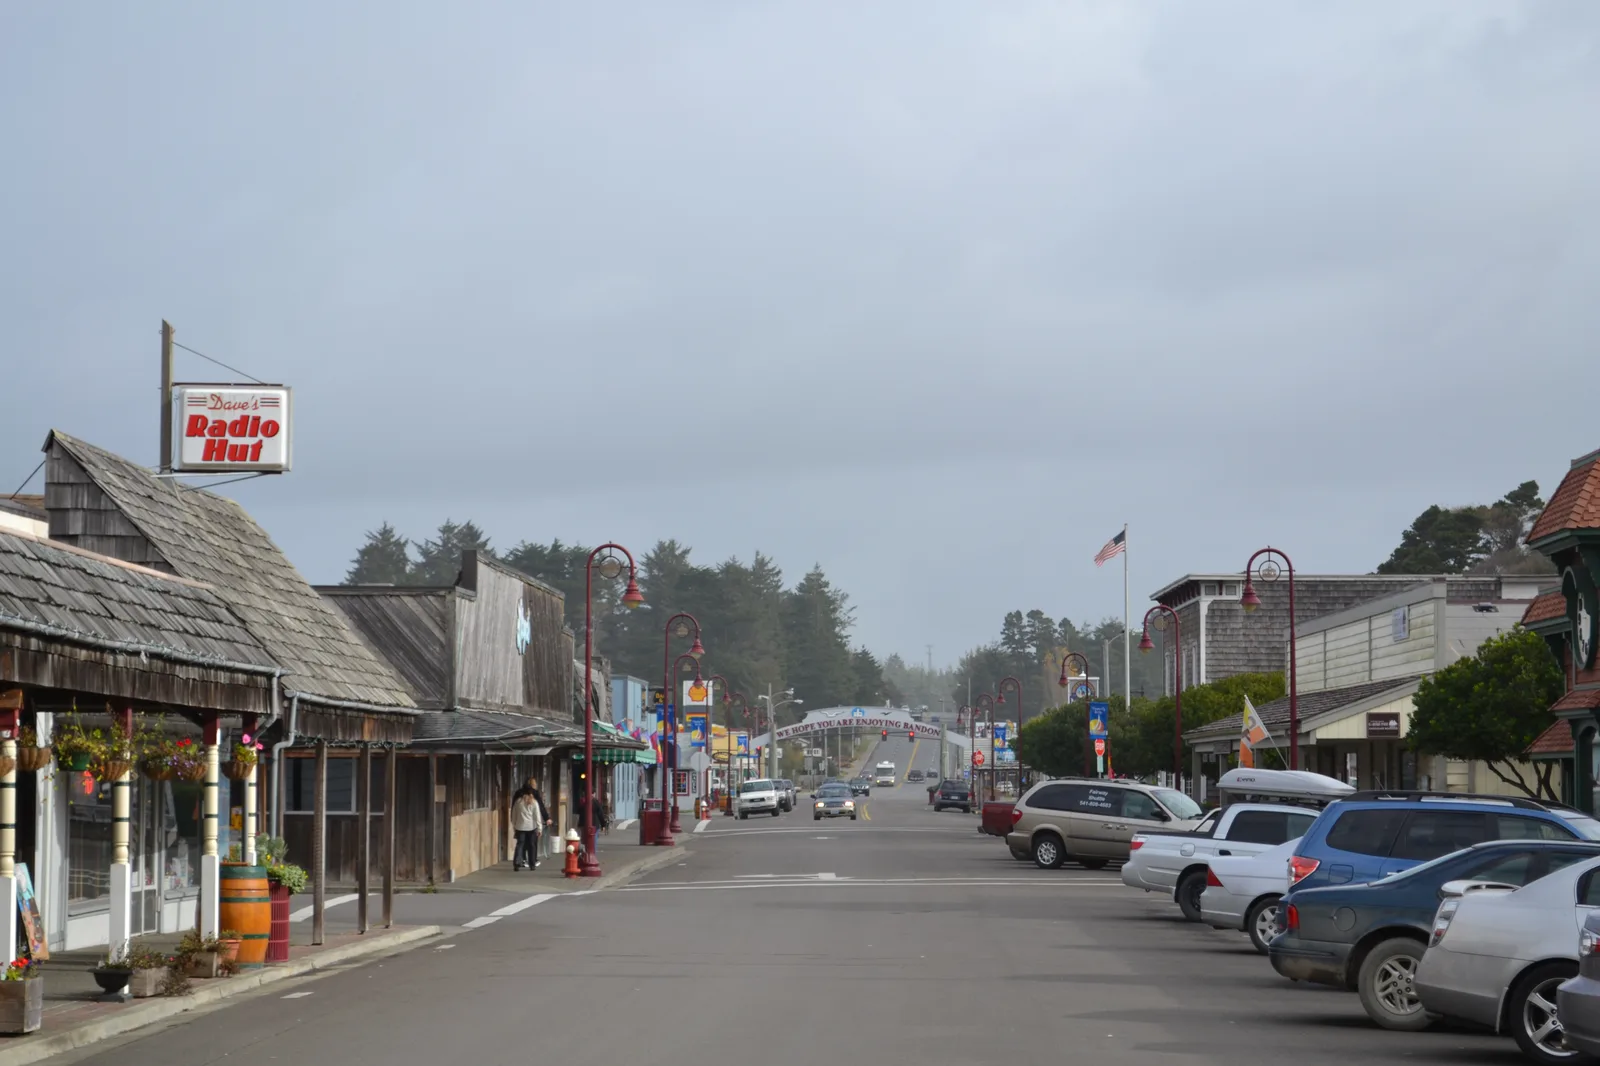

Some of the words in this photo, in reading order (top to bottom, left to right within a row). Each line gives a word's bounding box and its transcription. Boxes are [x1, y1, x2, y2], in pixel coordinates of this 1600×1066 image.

[208, 393, 260, 411] Dave's
[185, 414, 280, 438] Radio
[201, 438, 263, 462] Hut
[776, 729, 791, 739] WE
[791, 722, 816, 735] HOPE
[816, 719, 836, 729] YOU
[836, 718, 854, 727] ARE
[856, 718, 901, 729] ENJOYING
[903, 721, 941, 737] BANDON
